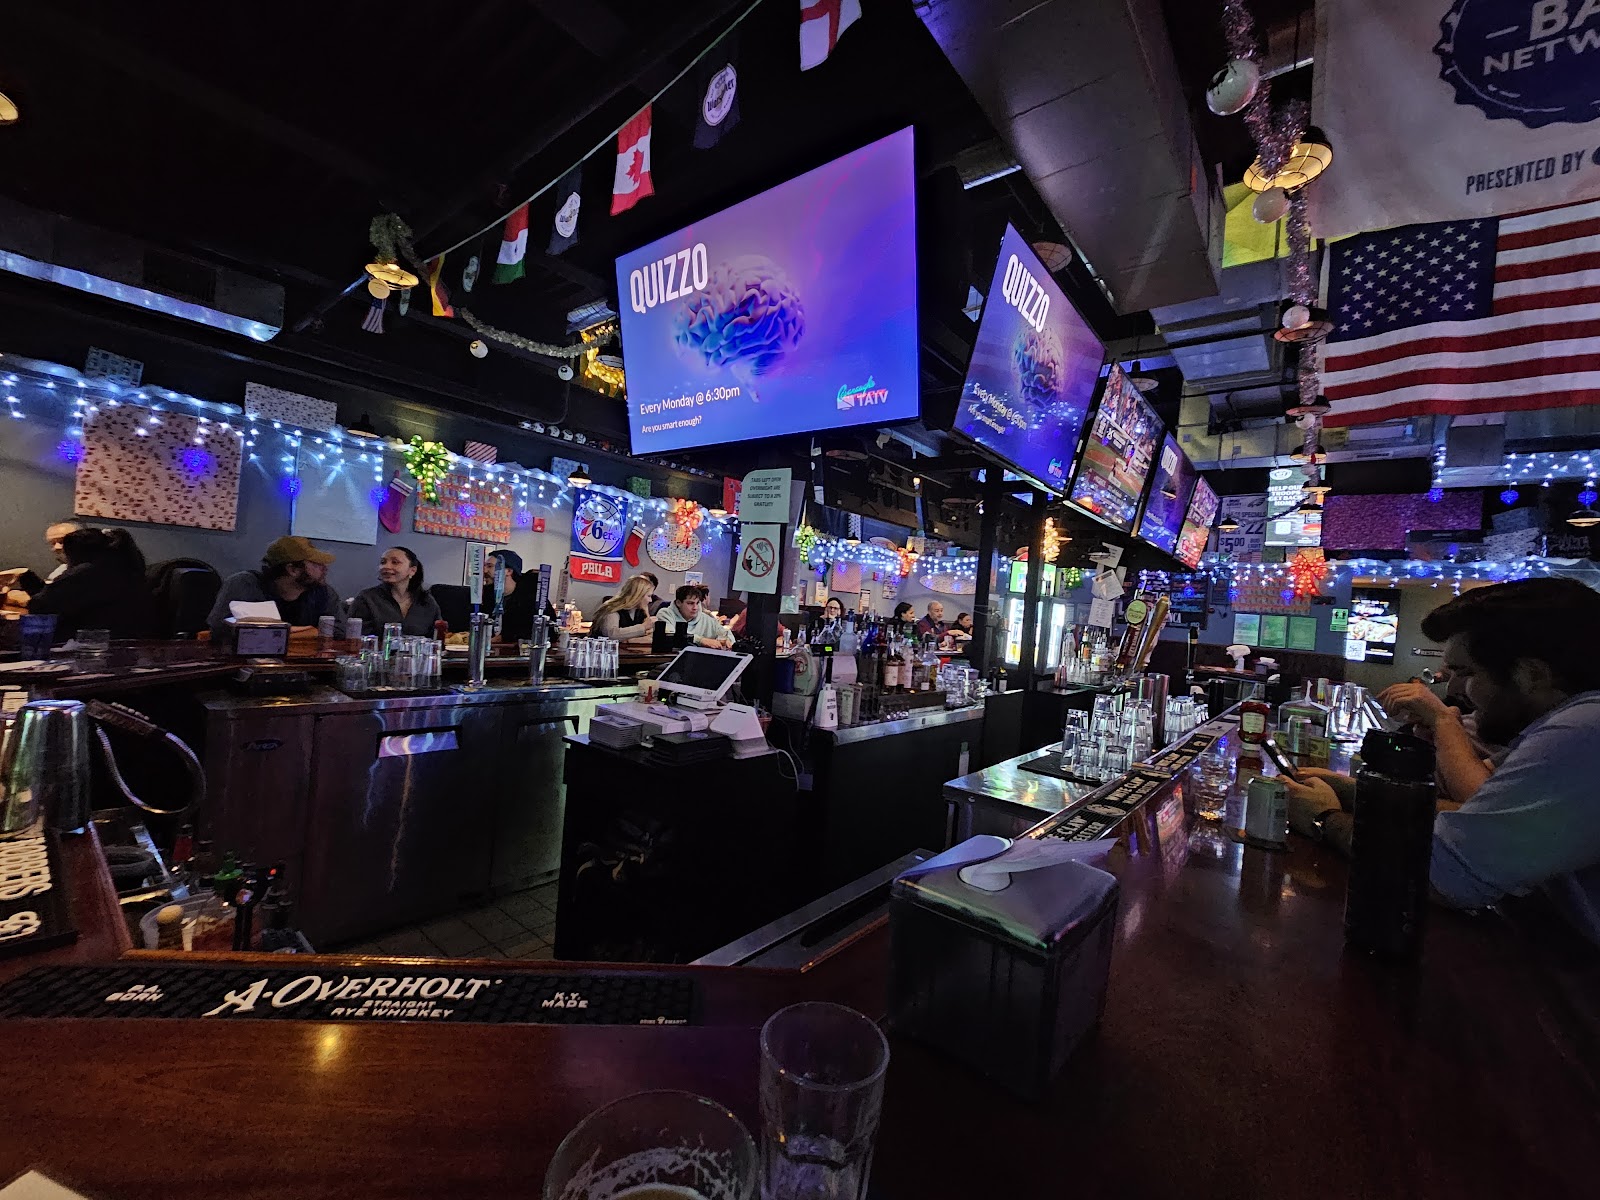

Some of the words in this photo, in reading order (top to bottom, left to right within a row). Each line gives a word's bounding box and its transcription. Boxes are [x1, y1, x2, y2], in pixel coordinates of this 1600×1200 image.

[1483, 29, 1600, 76] NETW
[1466, 157, 1556, 195] PRESENTED
[1561, 149, 1586, 175] BY
[630, 242, 708, 314] QUIZZO
[1002, 254, 1050, 333] QUIZZO
[640, 403, 661, 415] Every
[662, 394, 694, 411] Monday
[695, 392, 704, 405] @
[705, 386, 740, 402] 6:30pm
[642, 424, 651, 434] Are
[652, 423, 661, 433] you
[661, 420, 678, 430] smart
[678, 415, 702, 427] enough?
[580, 562, 614, 578] PHILA
[361, 999, 436, 1009] STRAIGHT
[541, 999, 589, 1009] MADE
[554, 991, 582, 1001] K.Y.
[330, 1006, 369, 1017] RYE
[371, 1006, 454, 1018] WHISKEY
